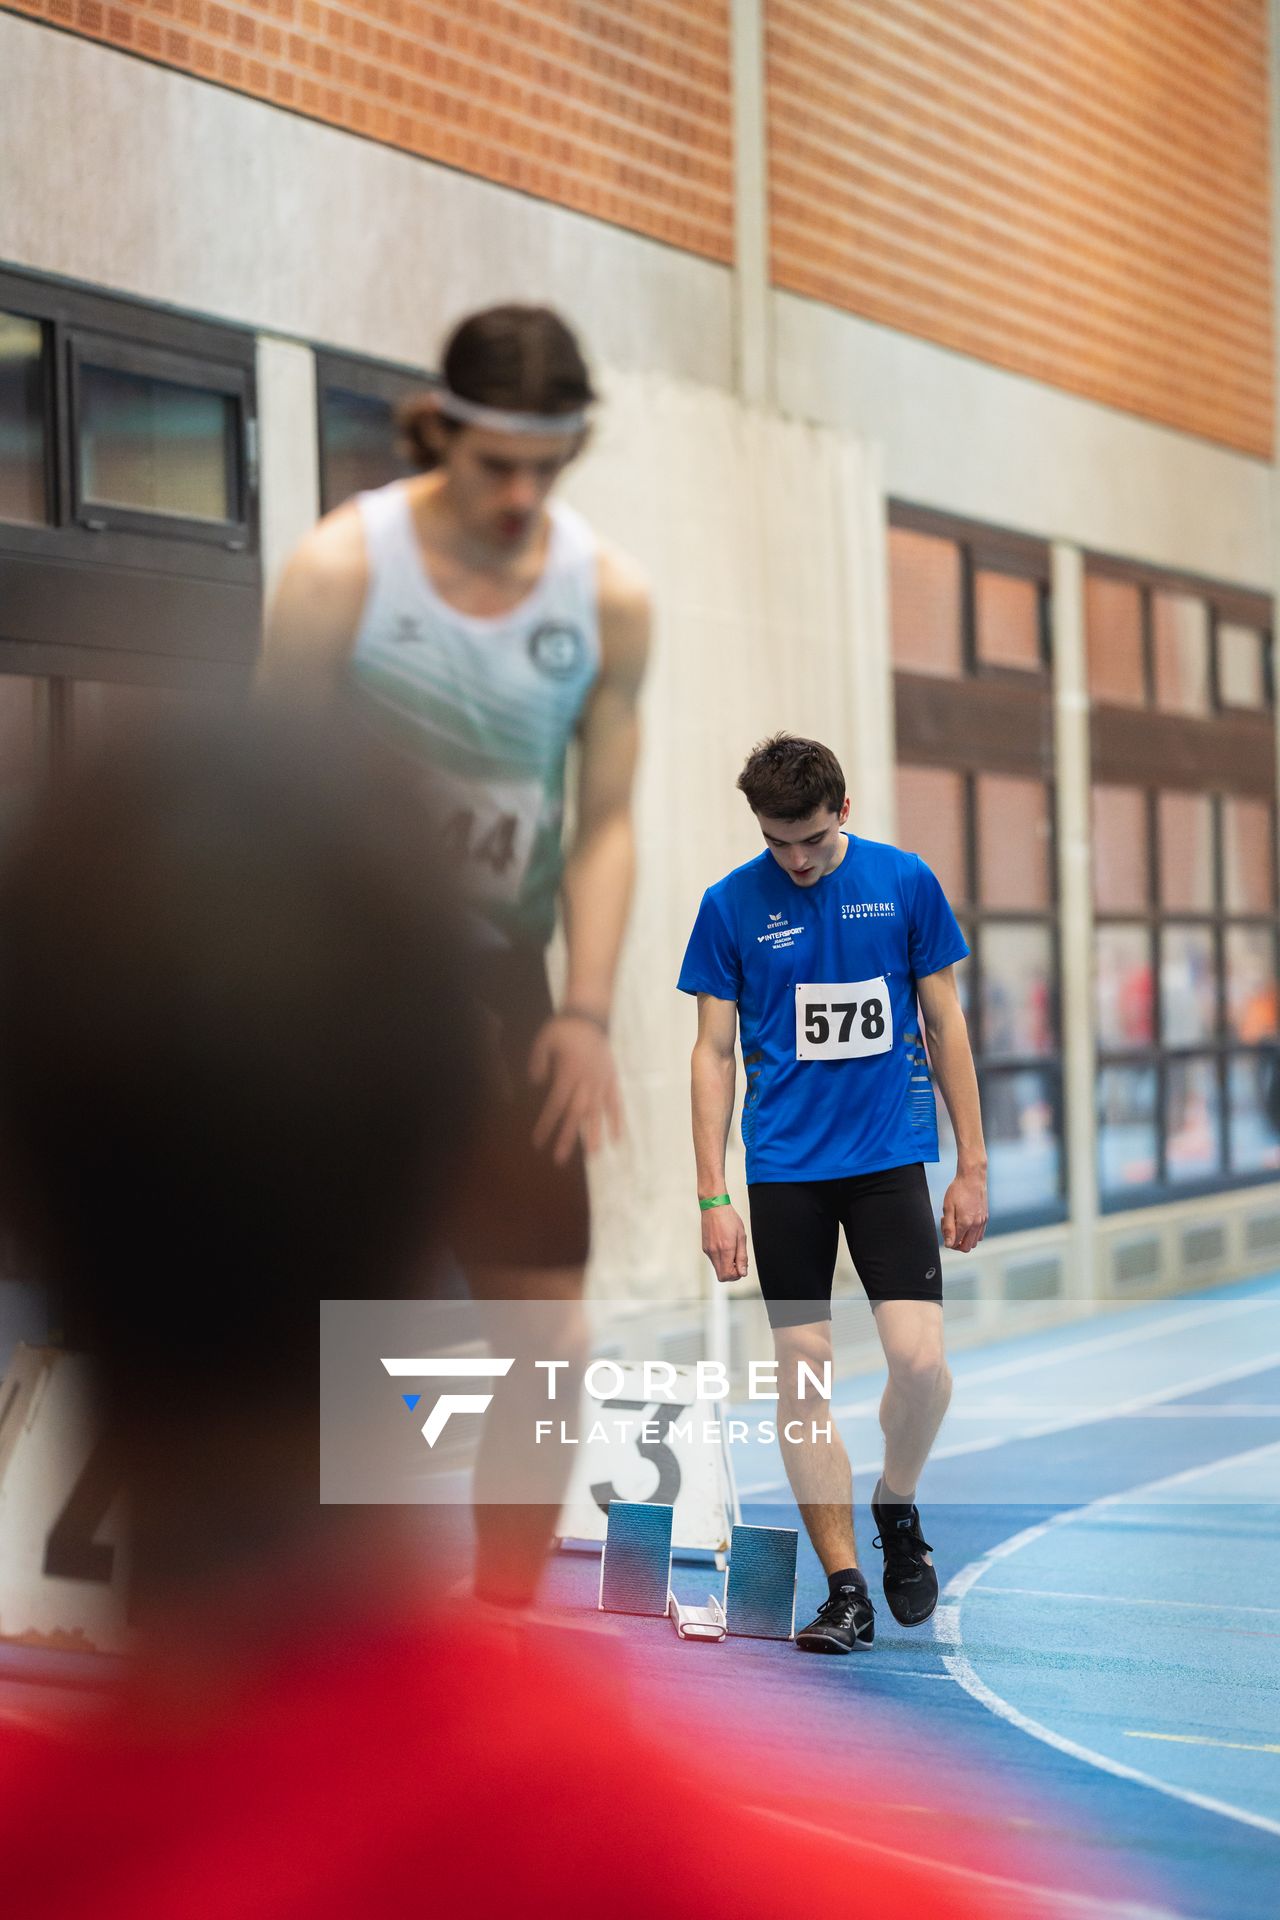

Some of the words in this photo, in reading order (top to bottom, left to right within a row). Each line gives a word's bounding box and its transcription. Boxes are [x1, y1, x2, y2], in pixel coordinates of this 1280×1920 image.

[841, 902, 895, 914] STADTWERKE
[766, 919, 789, 930] erima
[804, 998, 885, 1045] 578
[589, 1399, 686, 1516] 3
